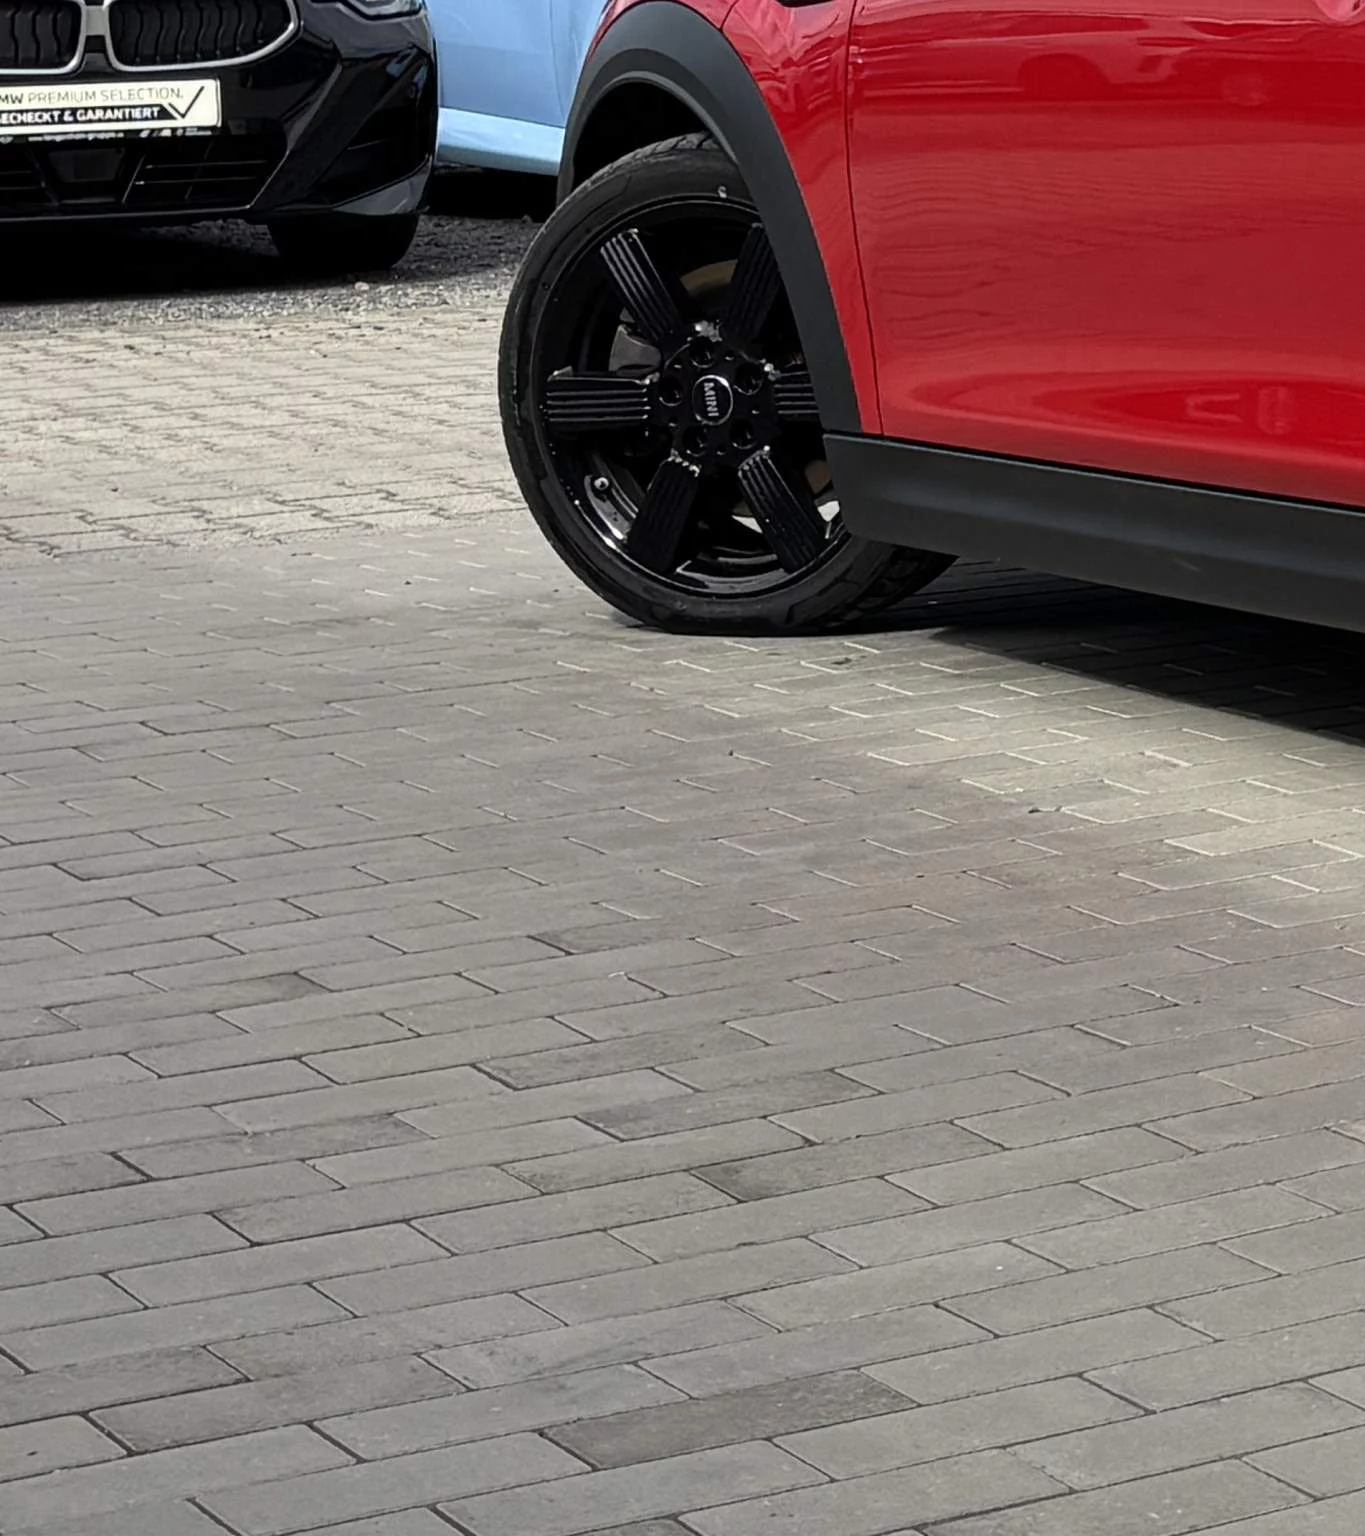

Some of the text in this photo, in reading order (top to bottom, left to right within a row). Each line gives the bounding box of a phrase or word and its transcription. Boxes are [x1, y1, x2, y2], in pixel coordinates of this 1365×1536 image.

[0, 93, 24, 104] MW
[27, 90, 97, 104] PREMIUM
[0, 110, 61, 124] ECHECKT
[76, 106, 161, 122] GARANTIERT
[703, 382, 720, 417] MINI
